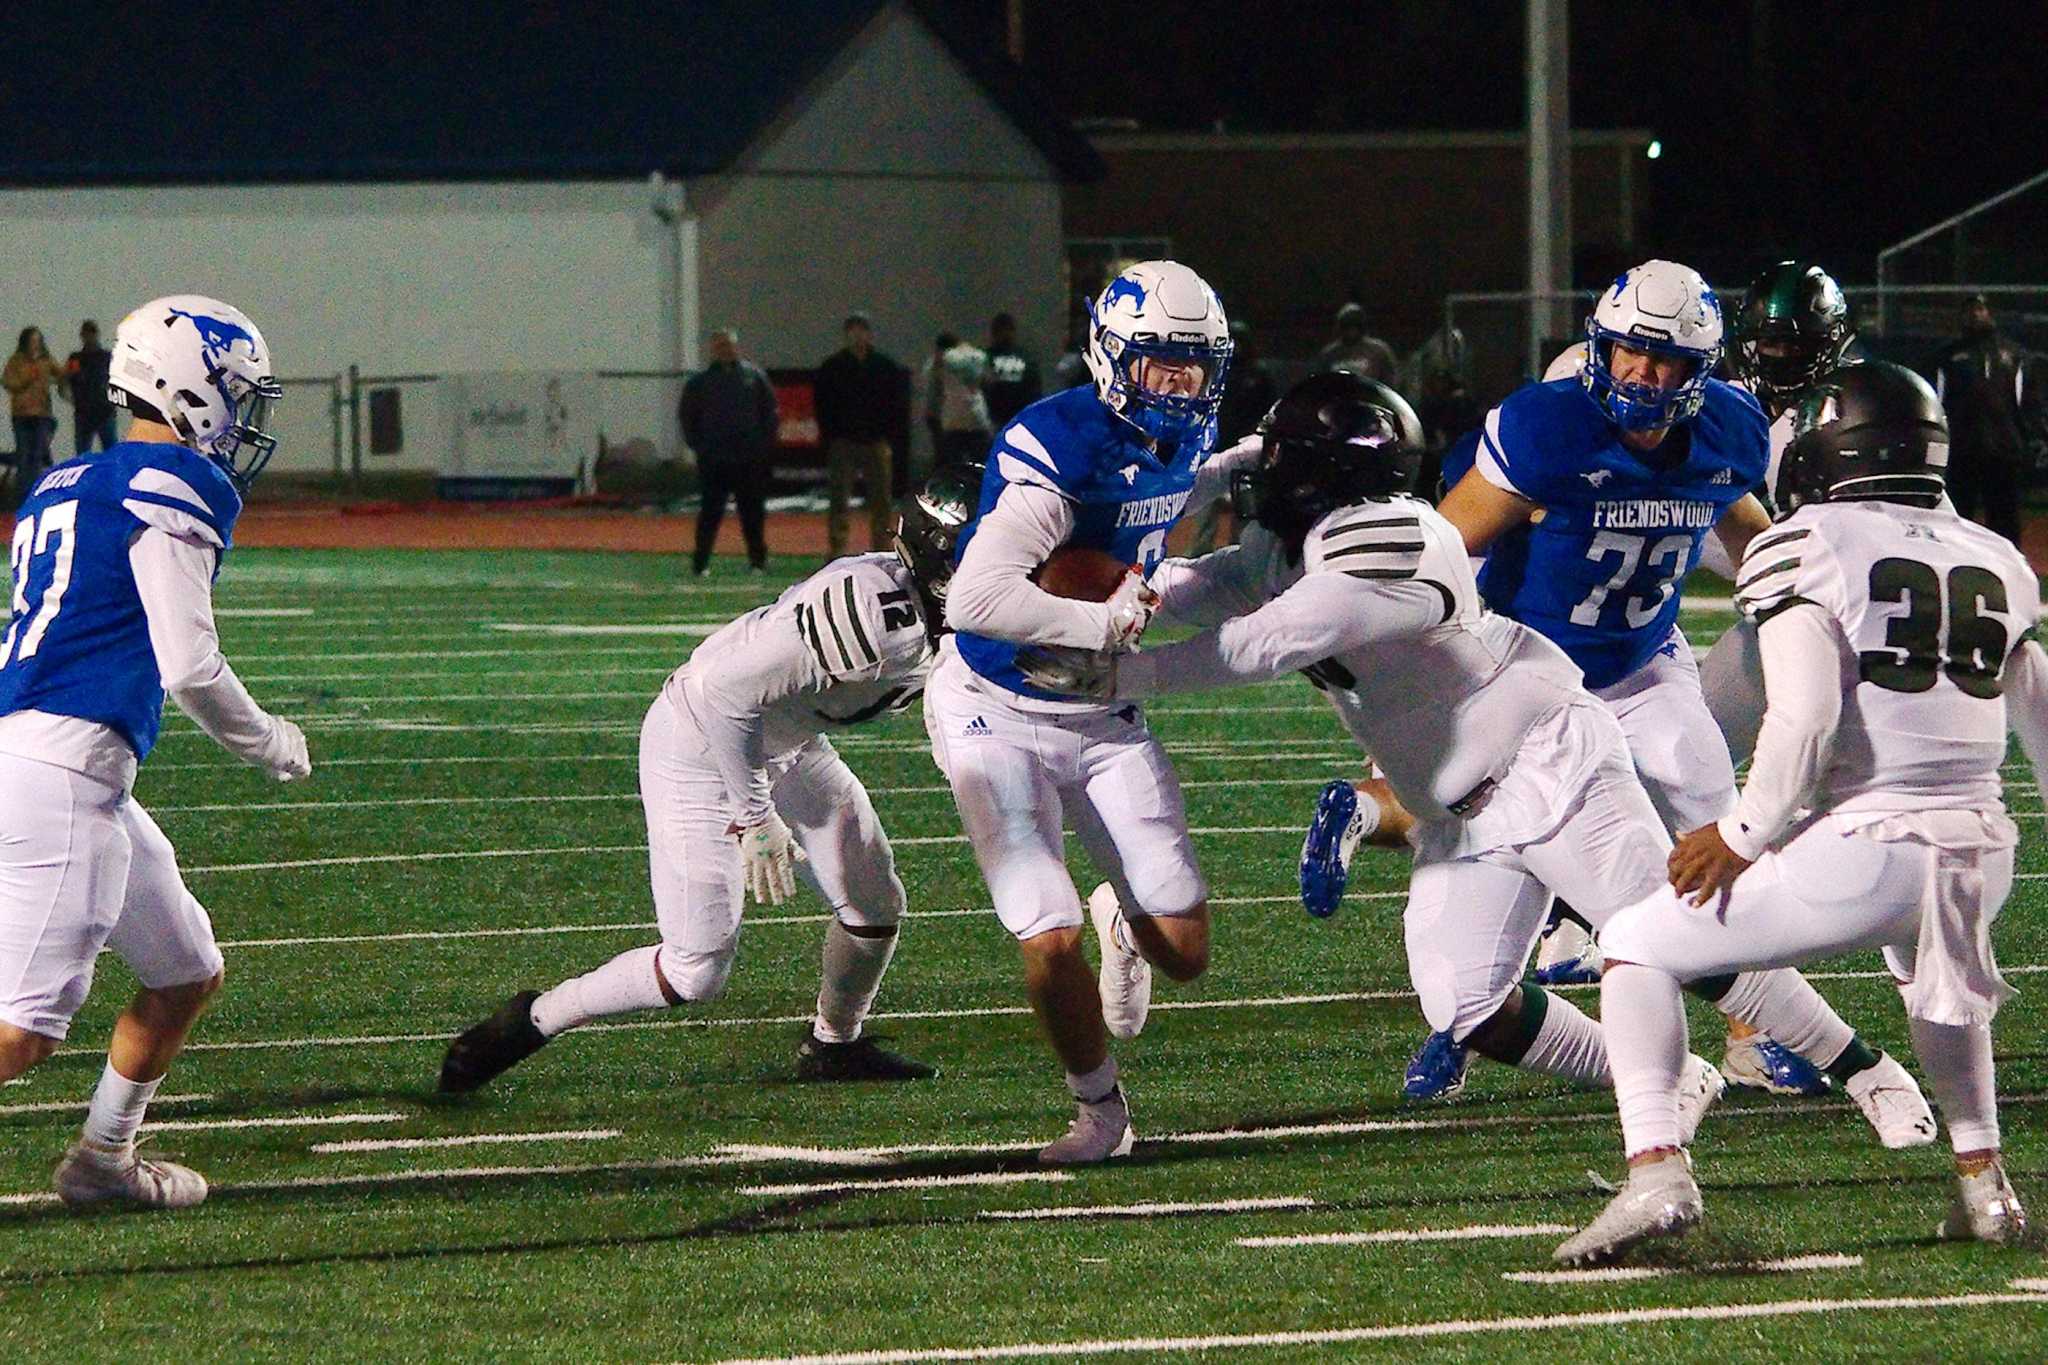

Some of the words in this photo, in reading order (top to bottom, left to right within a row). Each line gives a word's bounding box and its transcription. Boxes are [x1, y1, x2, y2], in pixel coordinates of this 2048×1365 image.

[1114, 488, 1194, 528] FRIENDSW
[1592, 500, 1716, 528] FRIENDSWOOD
[0, 499, 79, 670] 37
[877, 590, 917, 633] 12
[1569, 530, 1693, 629] 73
[1859, 557, 2009, 700] 36
